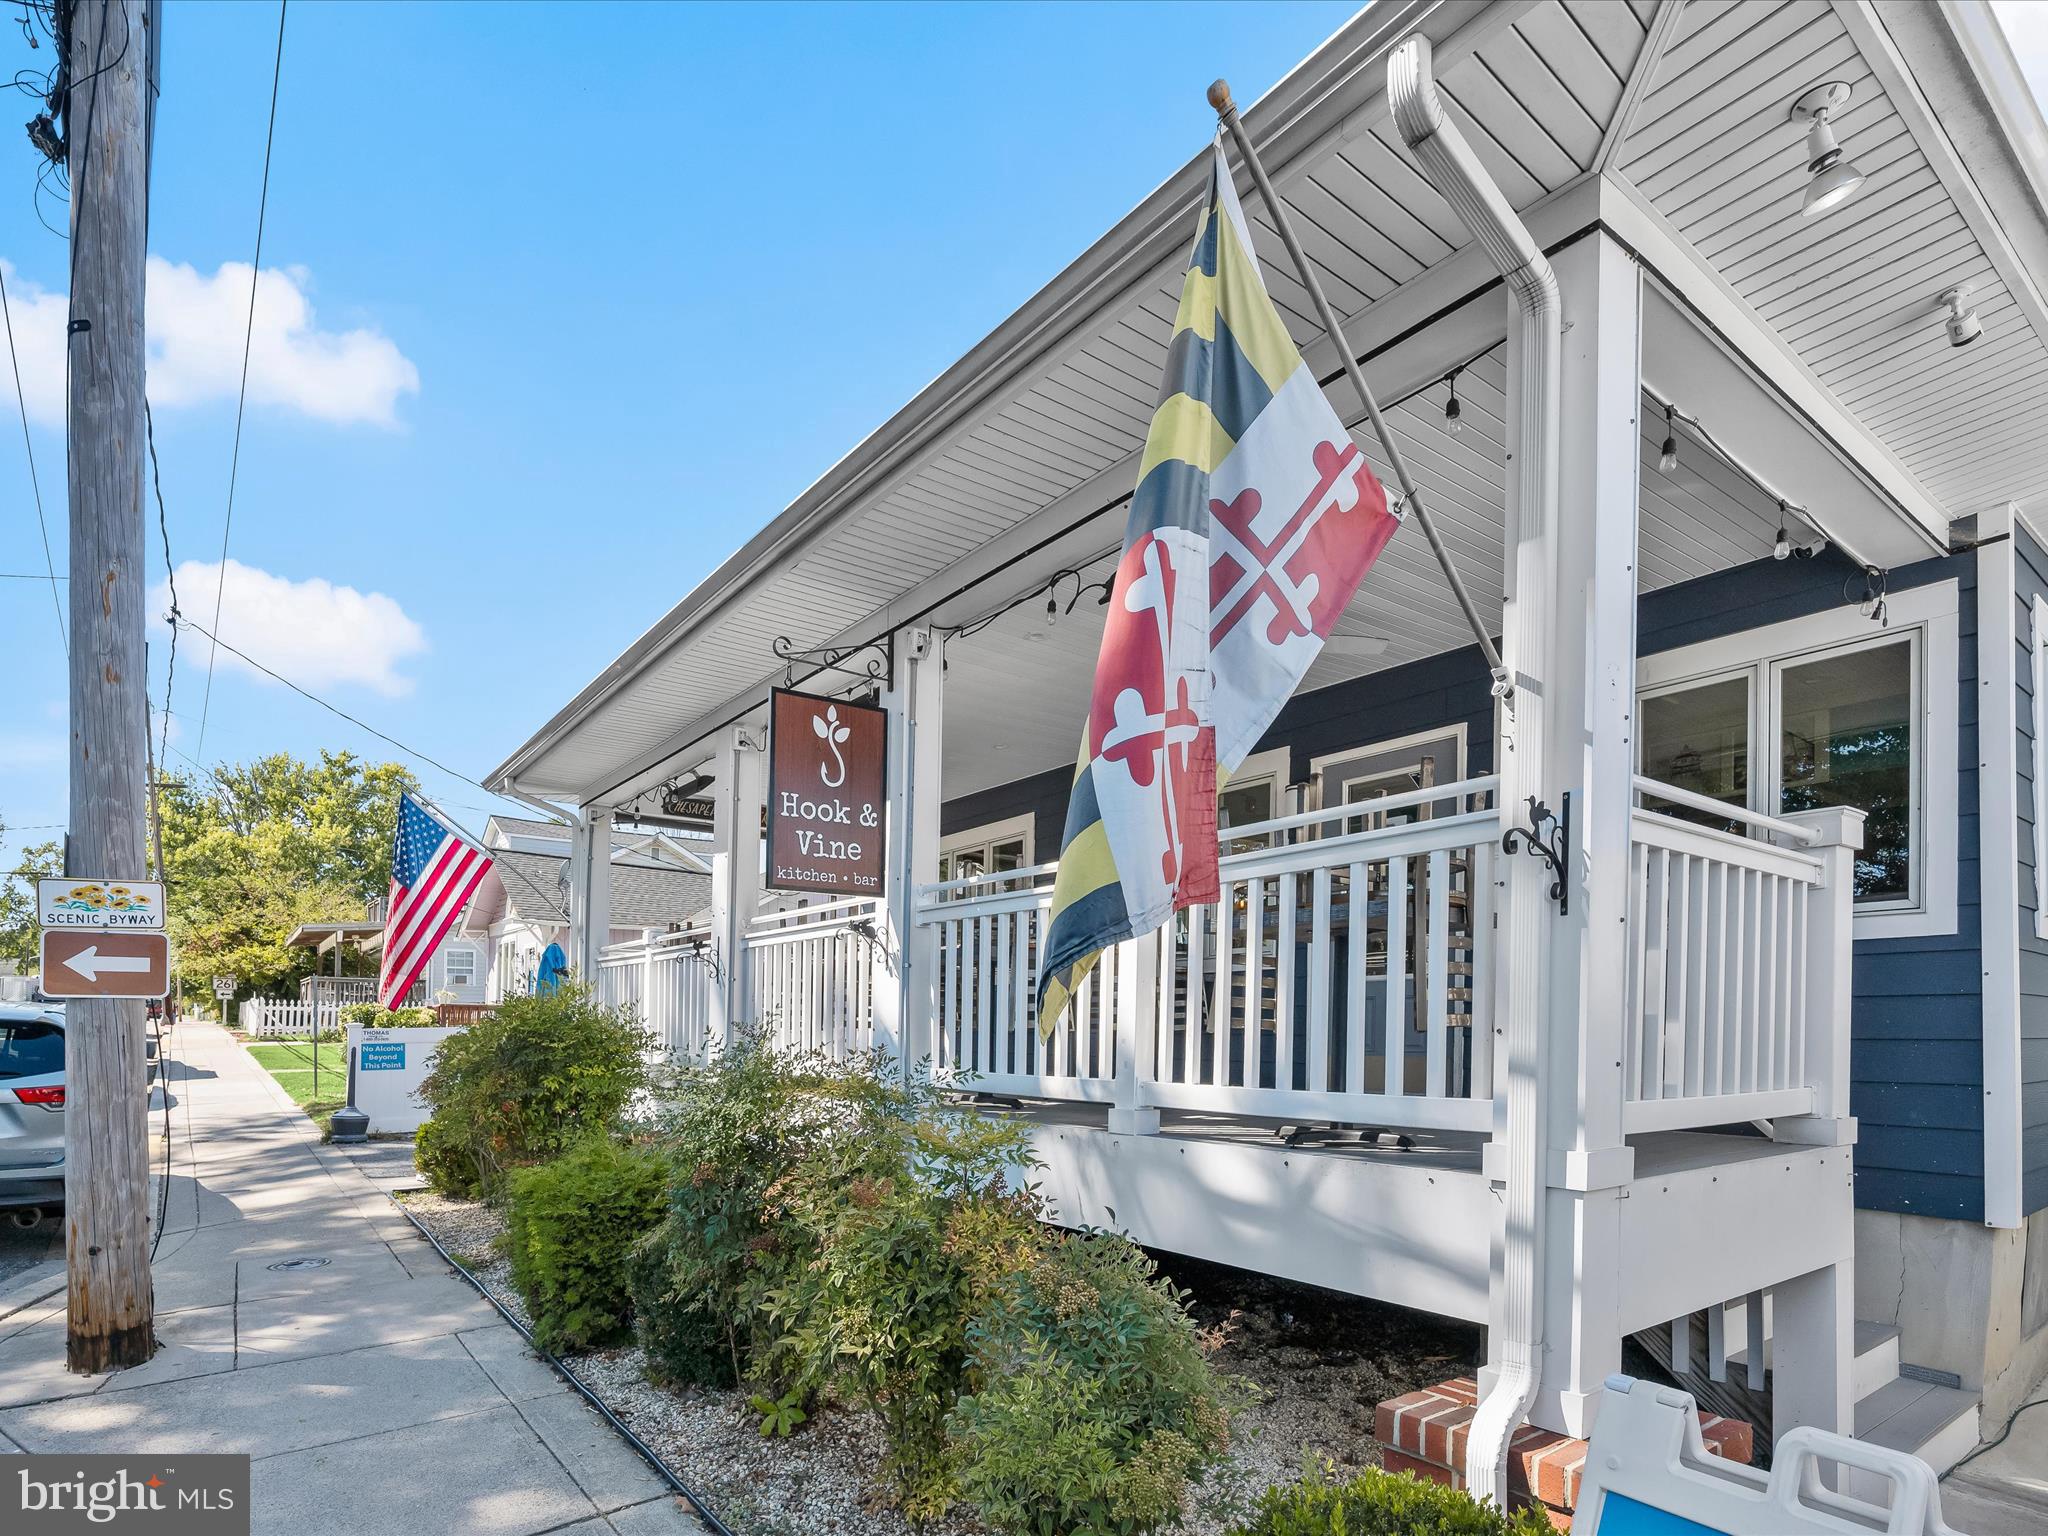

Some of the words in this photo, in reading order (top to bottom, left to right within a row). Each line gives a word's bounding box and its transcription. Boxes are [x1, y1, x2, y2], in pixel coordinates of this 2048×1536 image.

[781, 791, 851, 825] Hook
[859, 803, 878, 827] &
[795, 830, 862, 861] Vine
[777, 865, 837, 883] kitchen
[853, 872, 878, 886] bar
[47, 913, 100, 924] SCENIC
[109, 914, 156, 925] BYWAY
[216, 979, 234, 989] 261
[368, 1054, 398, 1062] Beyond
